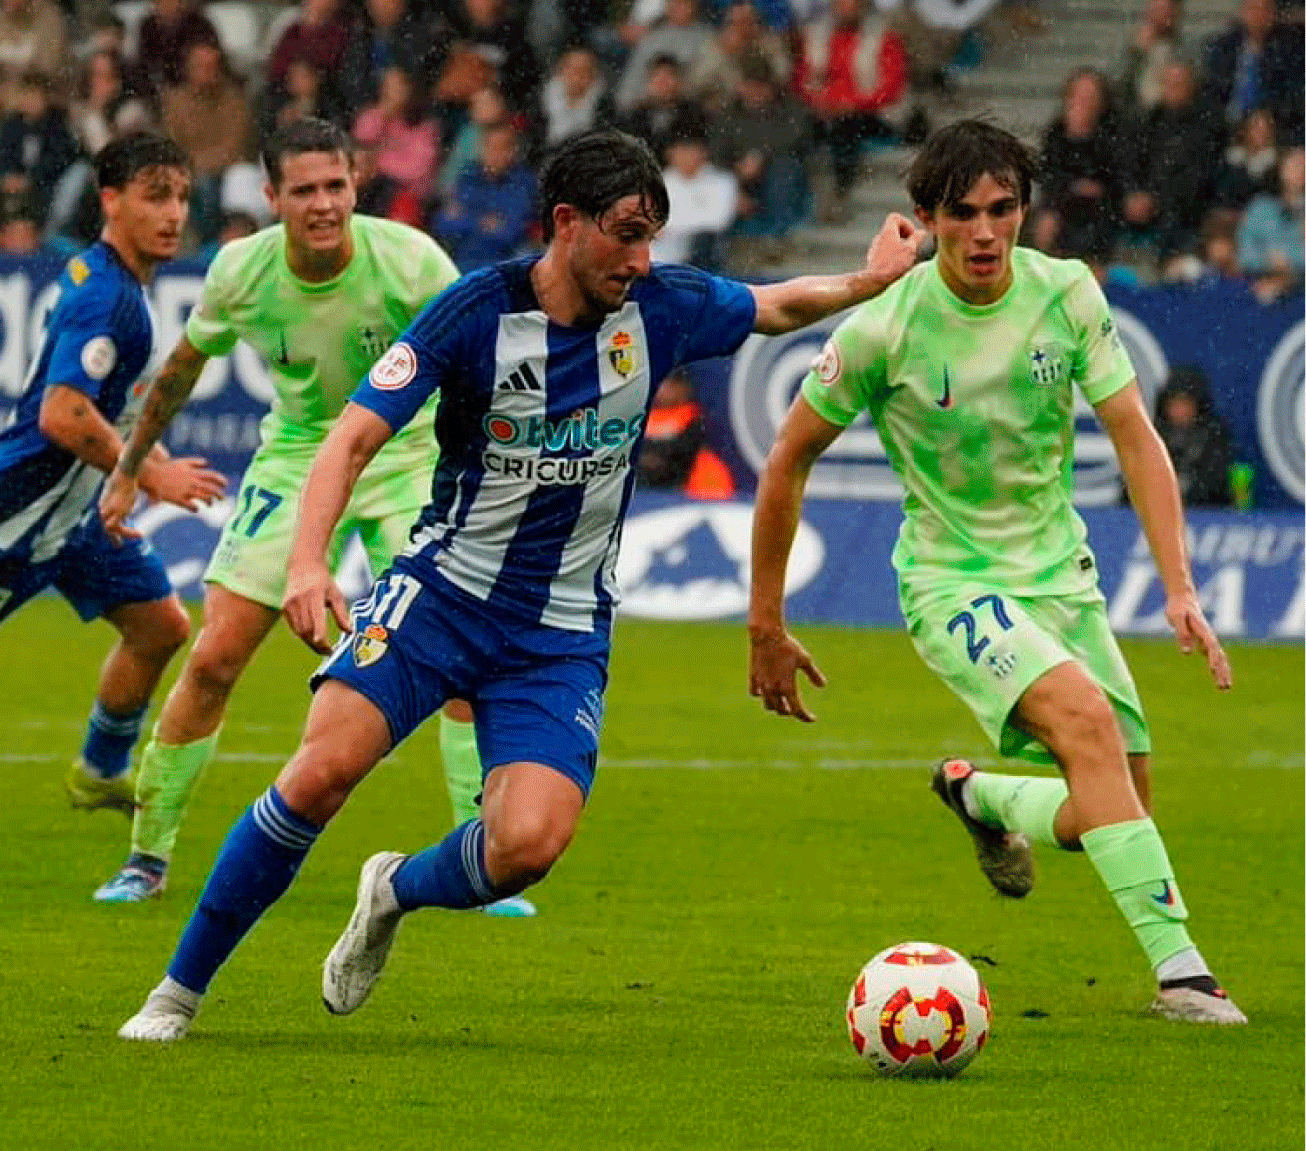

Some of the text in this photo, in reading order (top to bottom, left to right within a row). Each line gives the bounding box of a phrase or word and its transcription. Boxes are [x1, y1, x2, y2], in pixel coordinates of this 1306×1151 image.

[484, 453, 627, 485] CRICURSA
[230, 484, 284, 537] 17
[371, 574, 422, 631] 11
[946, 593, 1014, 665] 27
